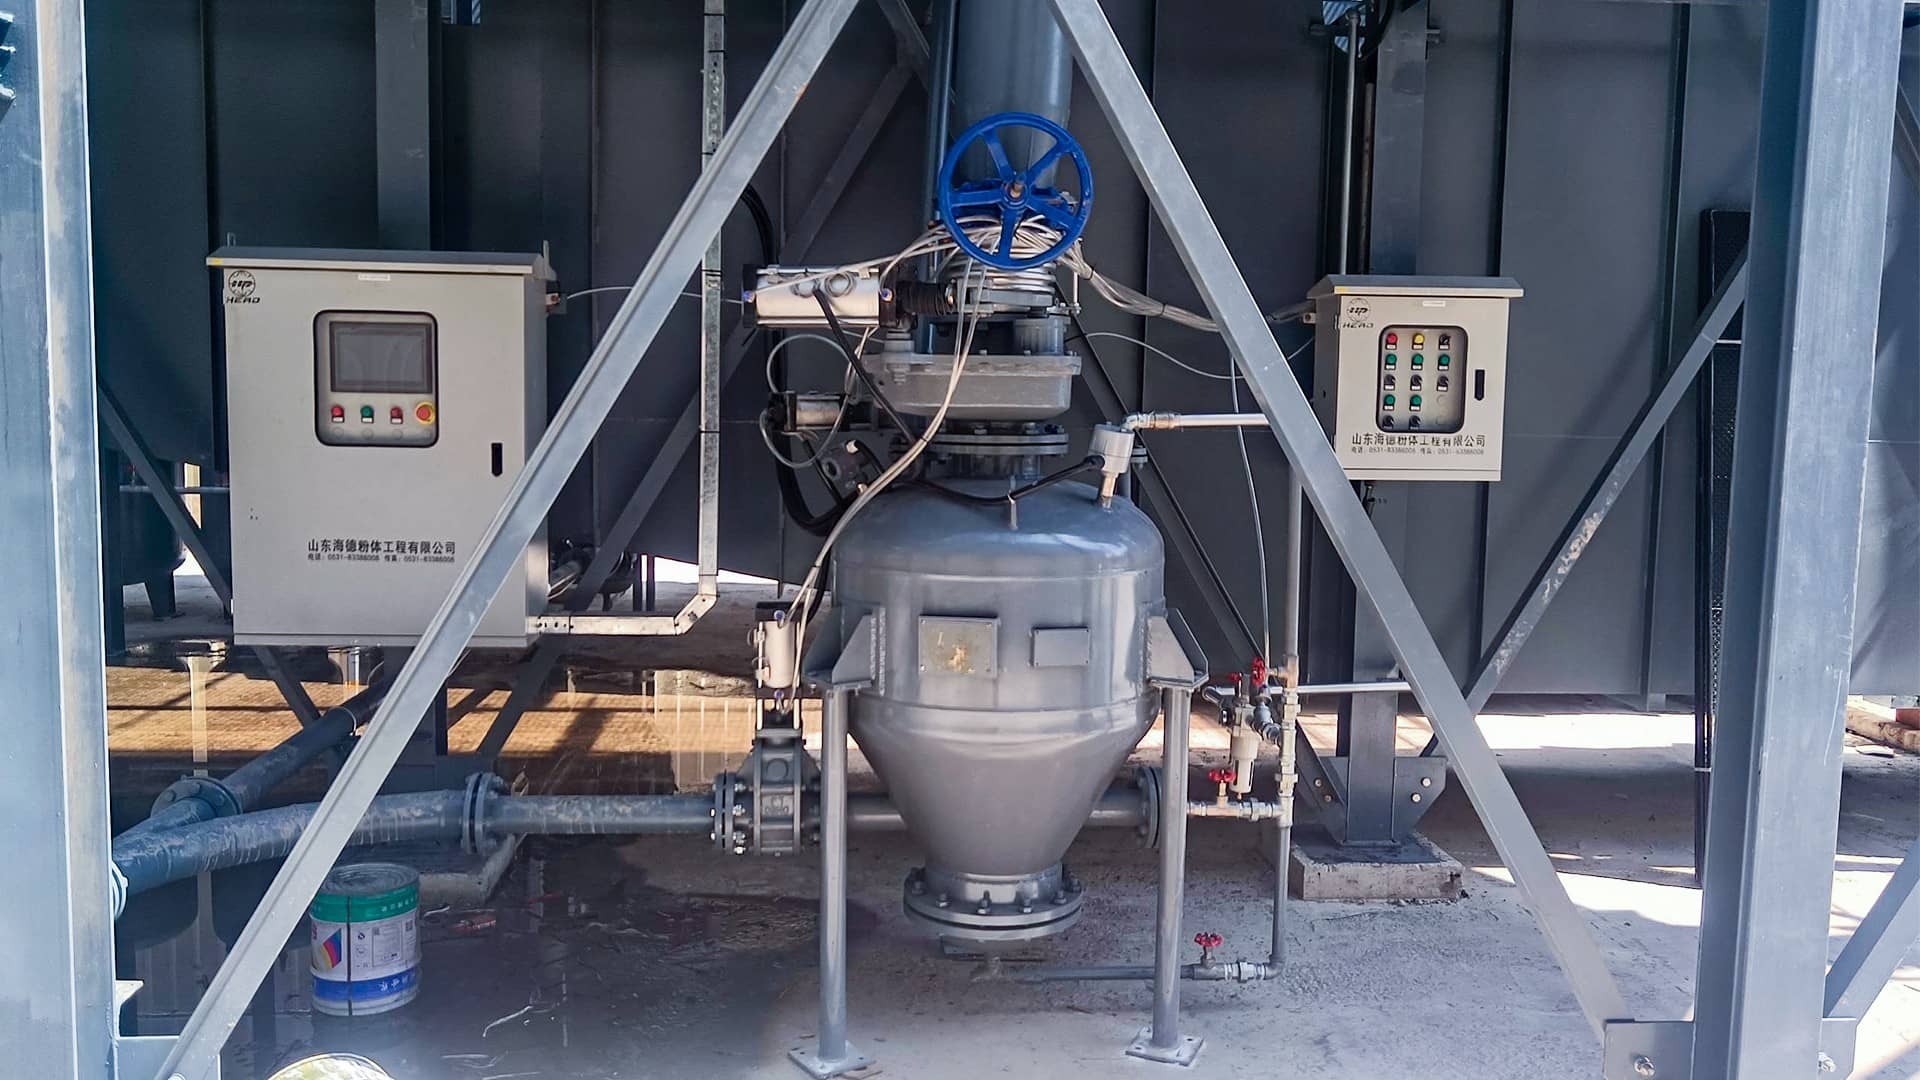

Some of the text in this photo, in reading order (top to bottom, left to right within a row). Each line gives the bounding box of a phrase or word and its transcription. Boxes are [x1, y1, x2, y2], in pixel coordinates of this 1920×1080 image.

[1351, 433, 1487, 448] 山东海德粉体工程有限公司
[307, 538, 457, 555] 山东海德粉体工程有限公司
